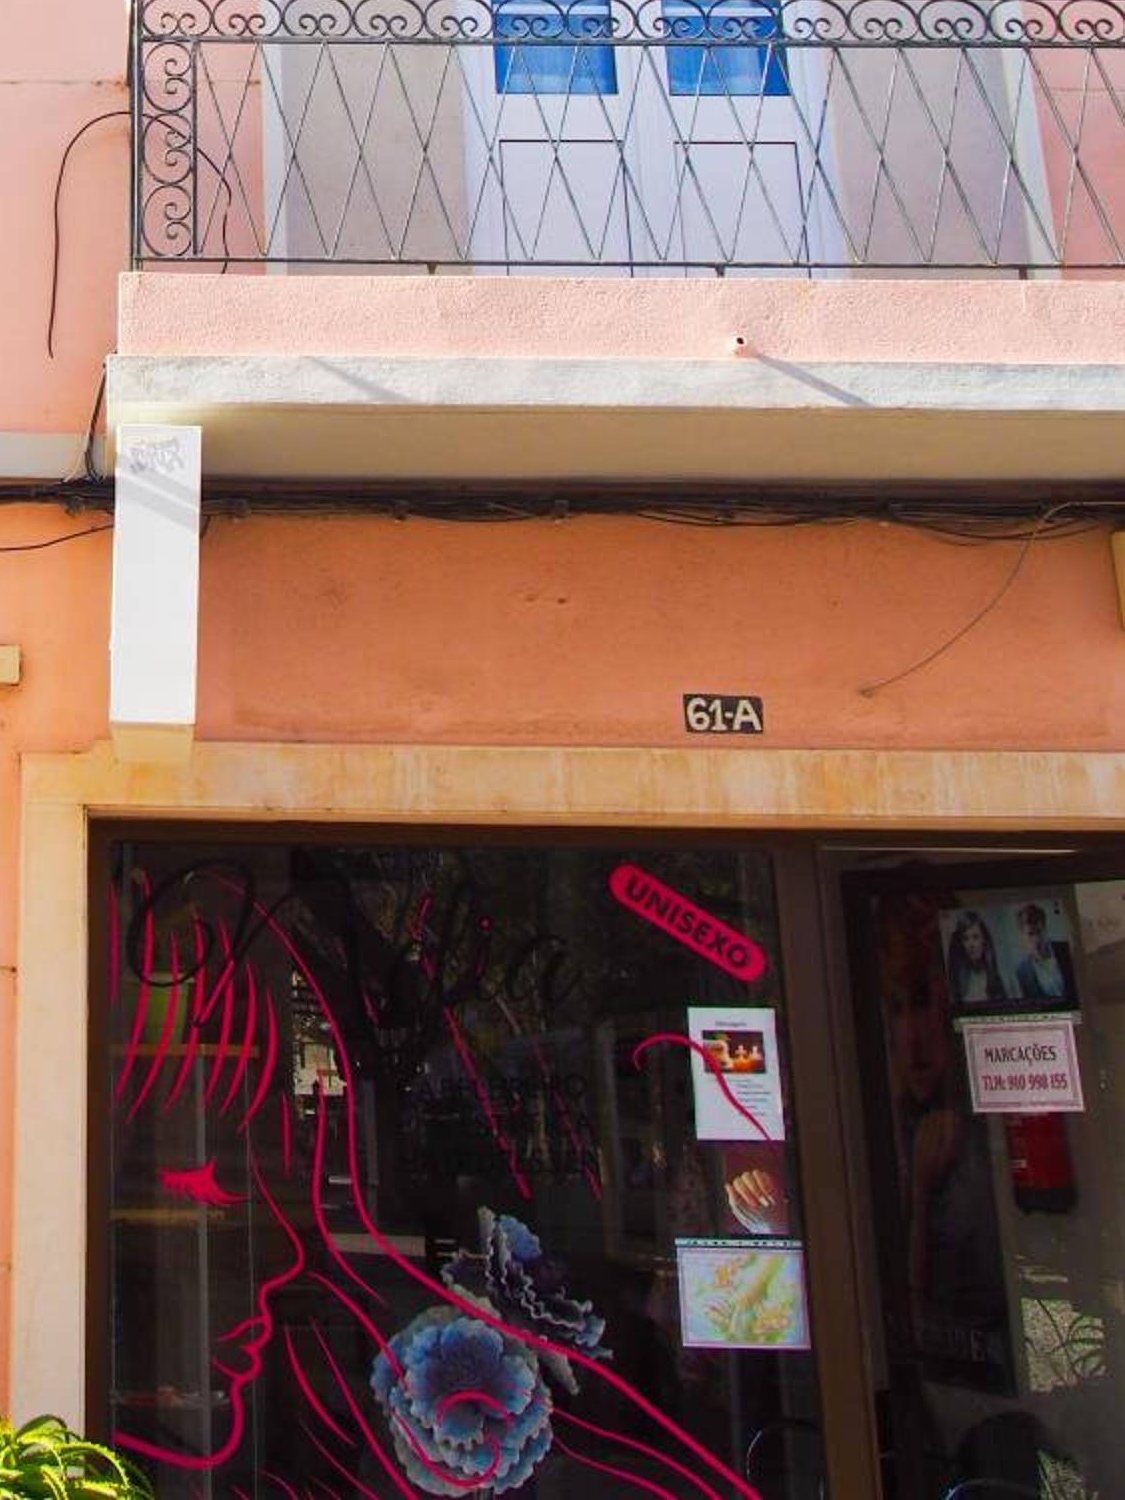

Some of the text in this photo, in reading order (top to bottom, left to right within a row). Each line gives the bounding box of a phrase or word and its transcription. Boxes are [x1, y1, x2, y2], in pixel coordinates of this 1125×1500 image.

[686, 697, 762, 731] 61-A
[625, 875, 750, 969] UNISEXO
[984, 1043, 1057, 1066] MARCAÇÕES
